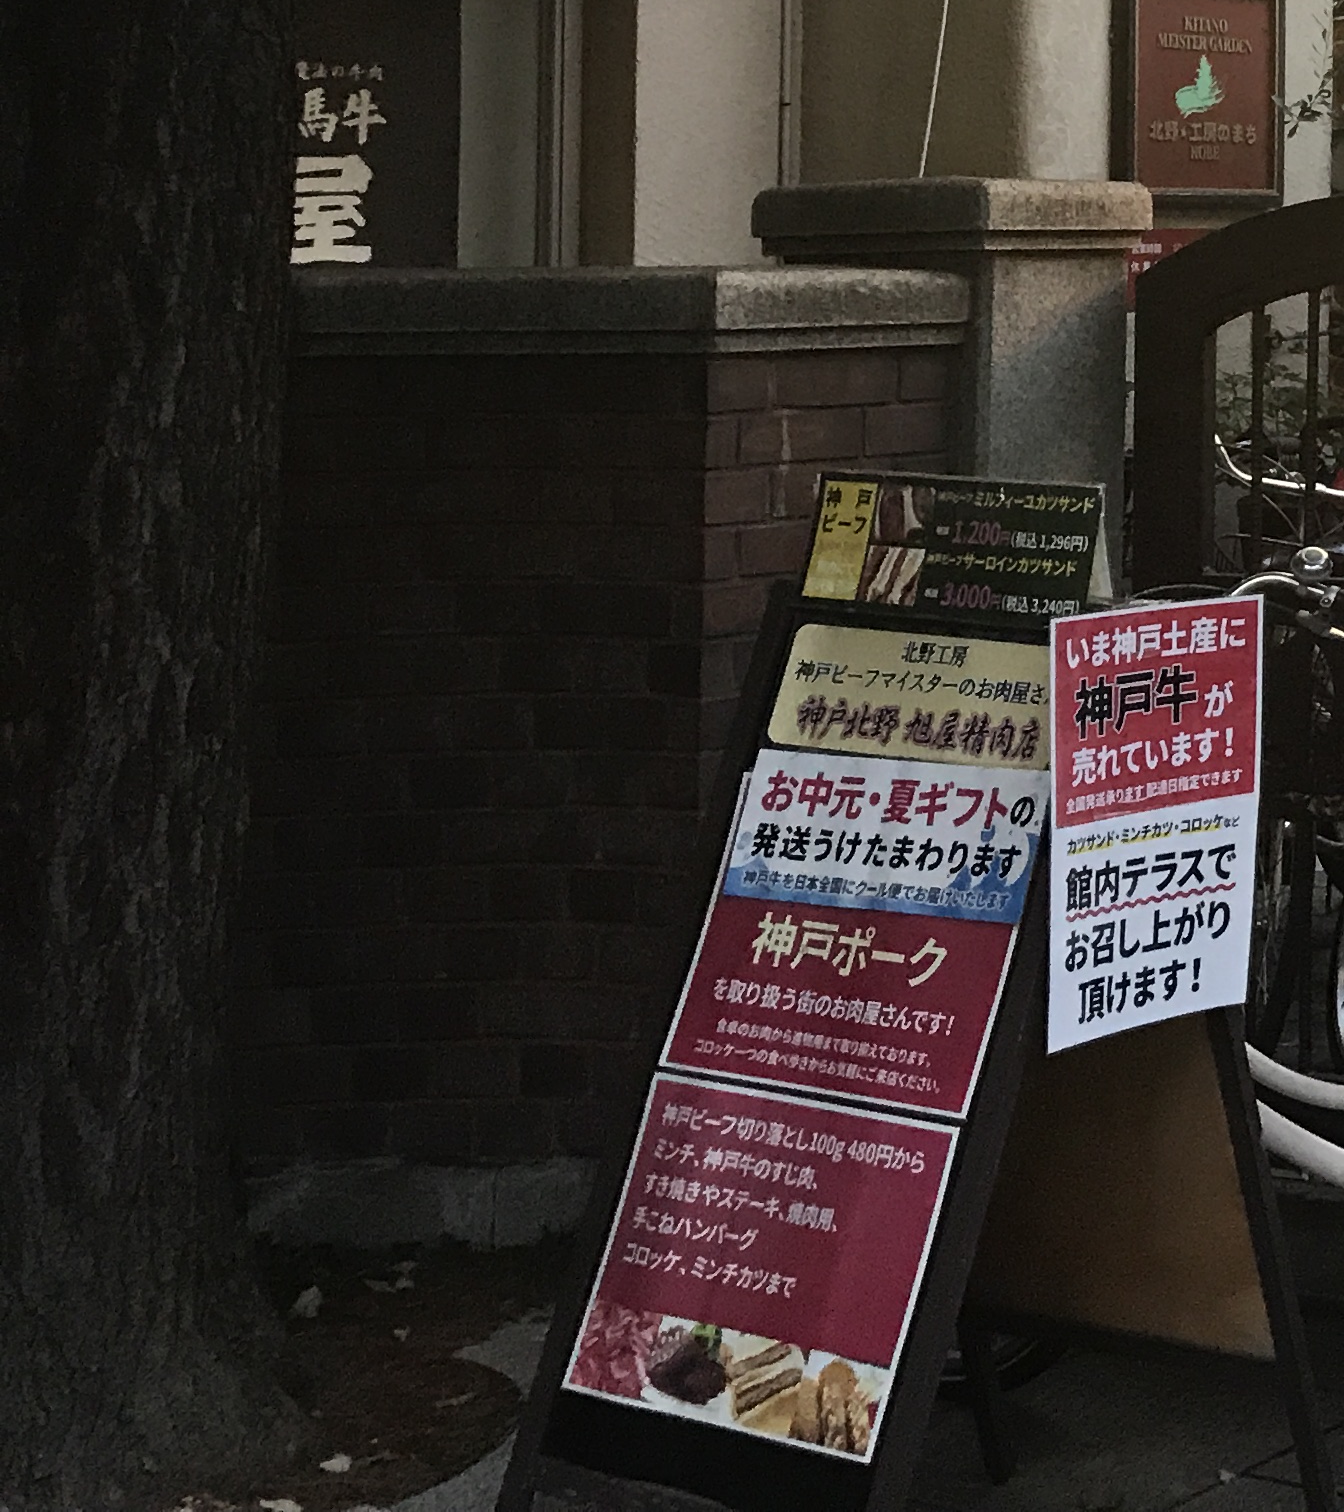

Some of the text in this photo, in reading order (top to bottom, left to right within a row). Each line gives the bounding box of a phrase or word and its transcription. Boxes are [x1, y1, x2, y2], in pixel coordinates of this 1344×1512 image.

[1158, 33, 1253, 54] MEISTER GARDEN
[1184, 16, 1228, 33] KITANO
[290, 154, 373, 265] 屋
[825, 487, 873, 508] 神戸
[821, 515, 868, 535] ビーフ
[901, 641, 970, 668] 北野工房
[1066, 617, 1246, 669] いま神戸土産に
[795, 660, 1049, 706] 神戸ビーフマイスターのお肉屋さ
[760, 769, 1038, 830] お中元・夏ギフトの
[751, 822, 1023, 880] 発送うけたまわります
[1065, 842, 1237, 914] 館内テラスで
[751, 911, 949, 988] 神戸ポーク
[1065, 900, 1231, 972] お召し上がり
[631, 1206, 760, 1252] 手こねハンバーグ
